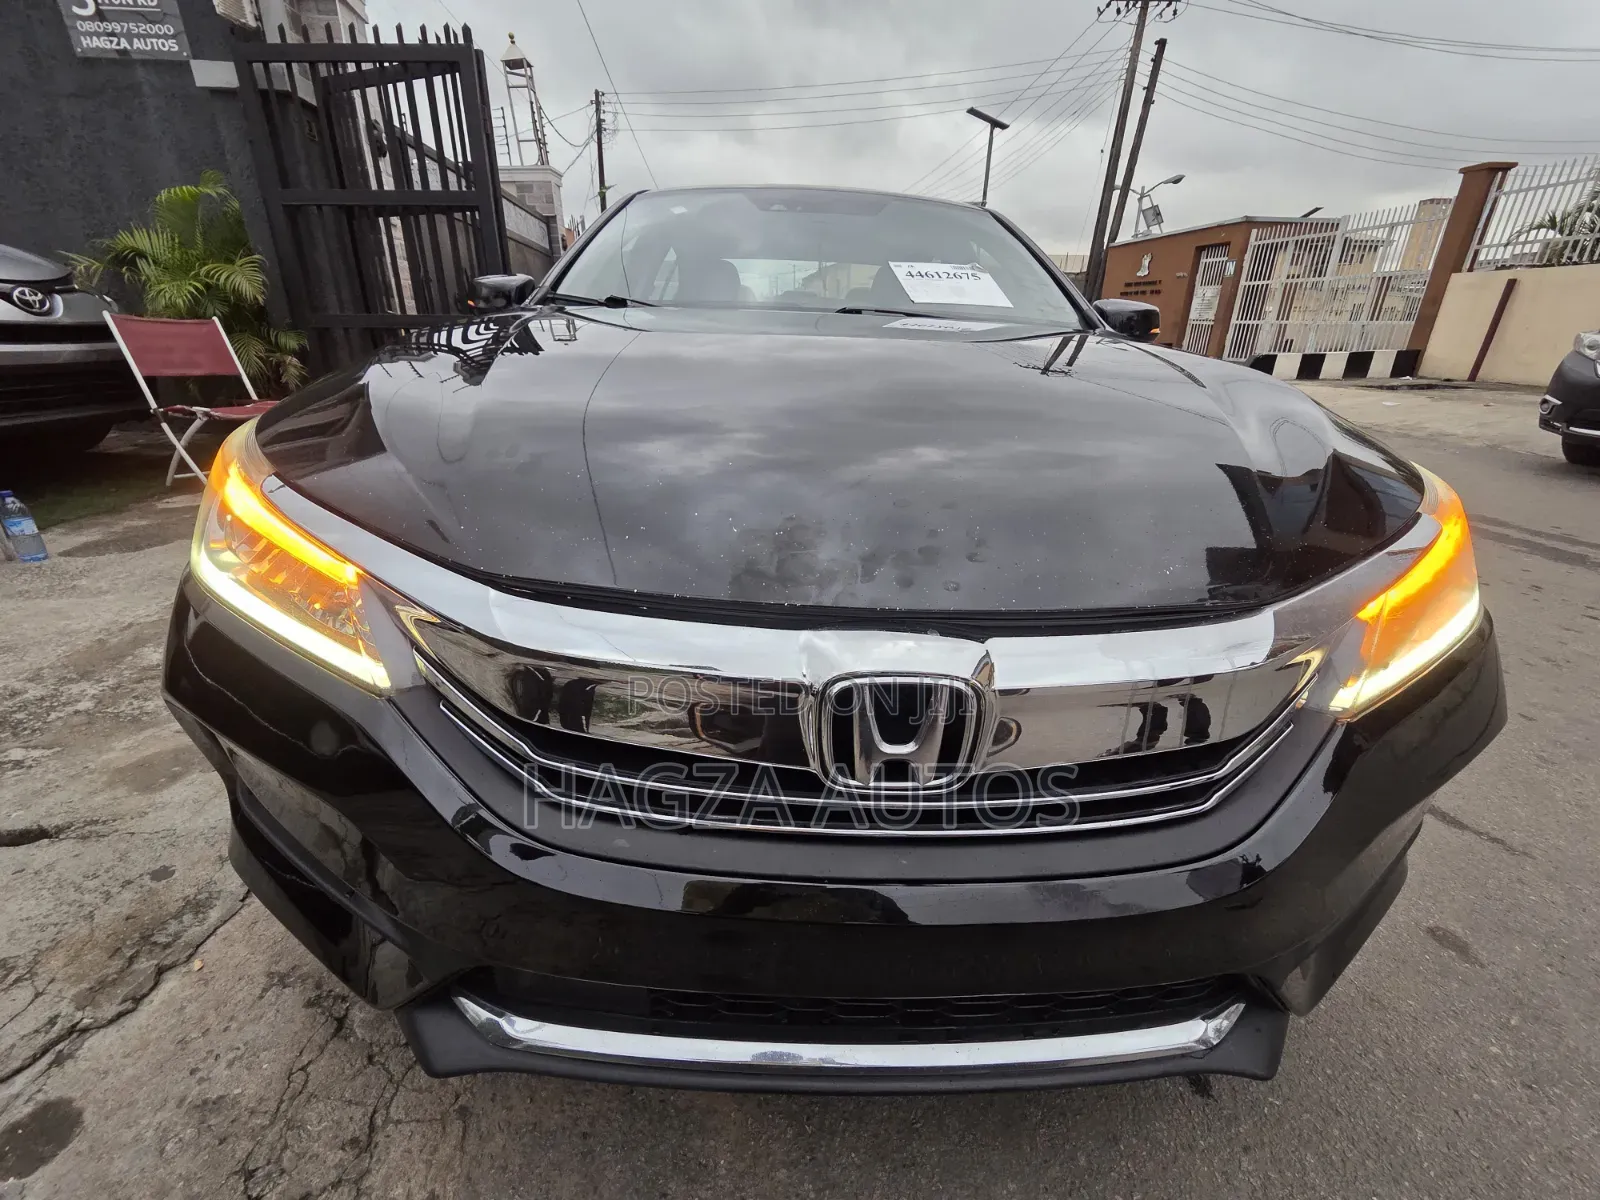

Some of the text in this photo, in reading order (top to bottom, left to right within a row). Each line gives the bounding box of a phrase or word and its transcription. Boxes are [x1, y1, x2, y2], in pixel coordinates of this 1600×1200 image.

[76, 20, 175, 35] 08099752000
[80, 36, 179, 51] HAGZA AUTOS
[905, 270, 981, 280] 44612675
